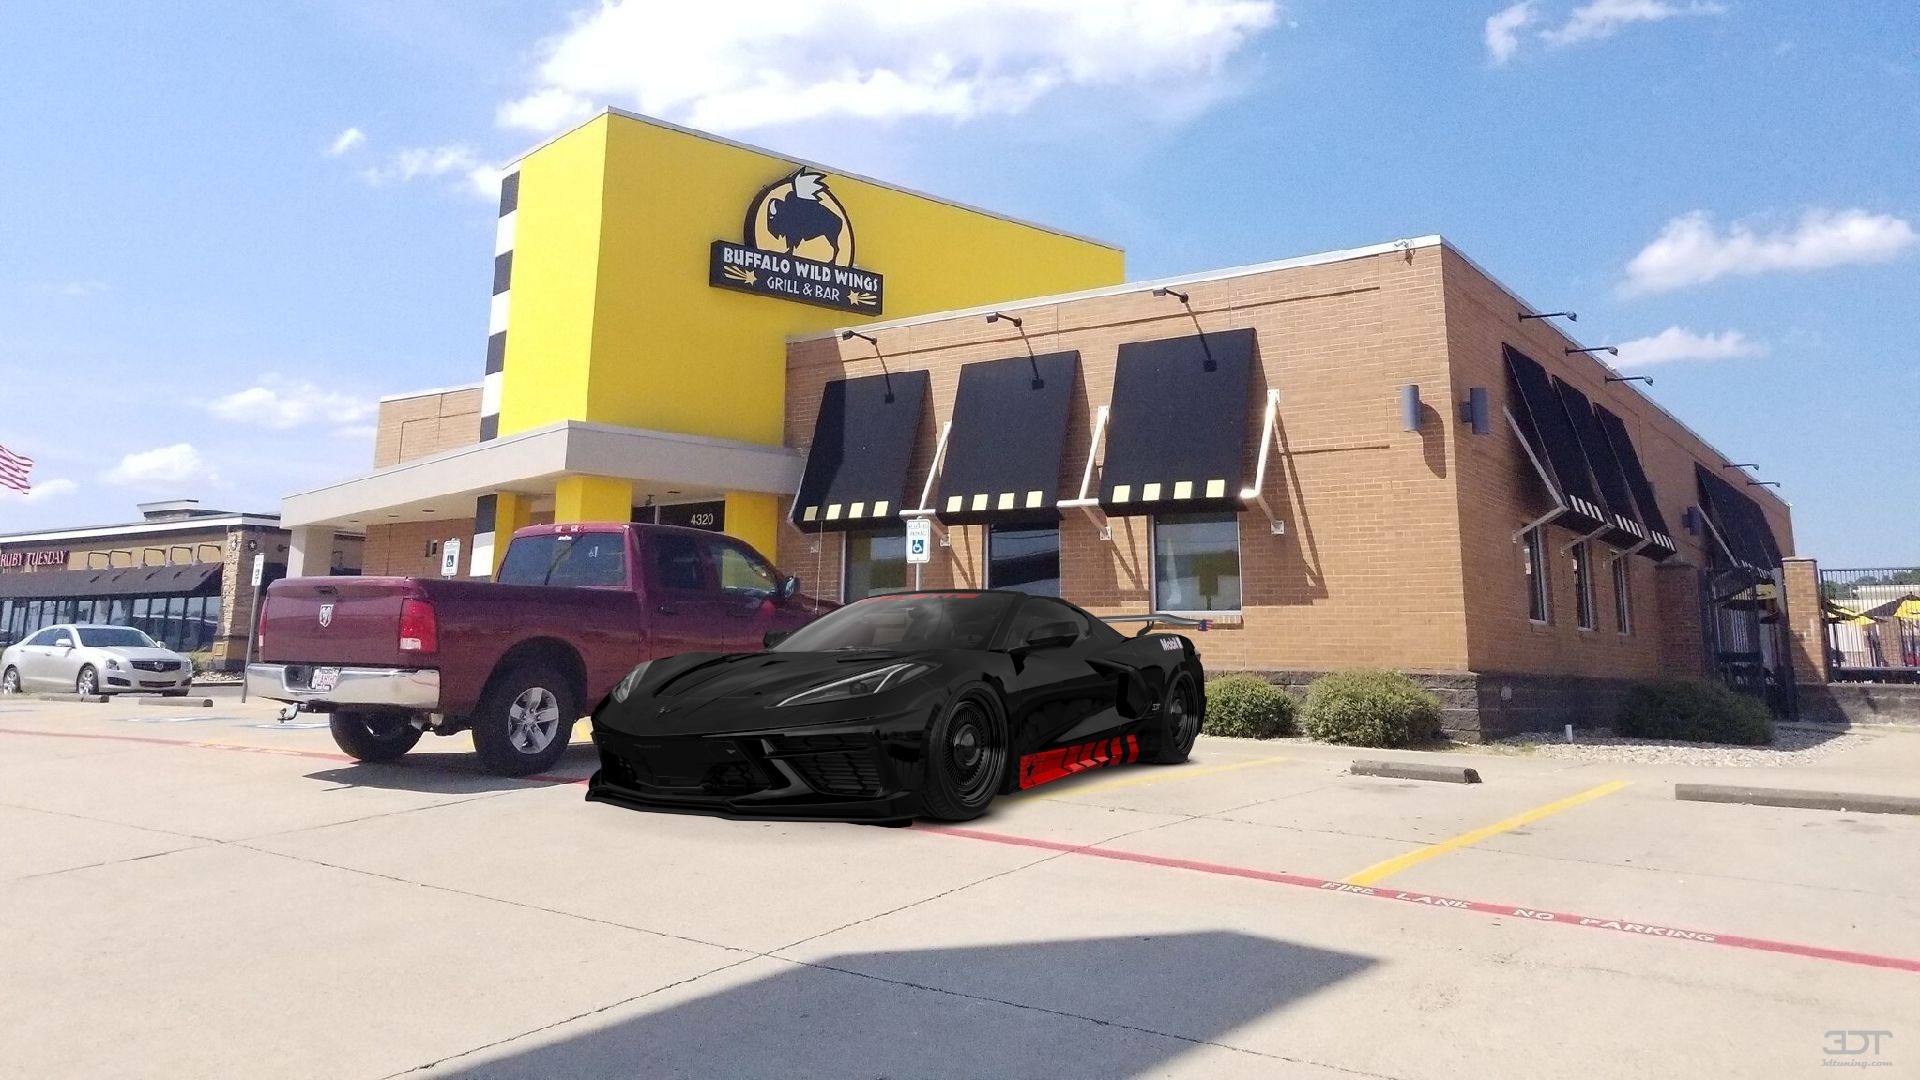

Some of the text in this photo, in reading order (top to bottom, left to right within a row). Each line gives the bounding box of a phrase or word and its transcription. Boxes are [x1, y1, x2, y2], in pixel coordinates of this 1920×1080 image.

[723, 247, 878, 292] BUFFALO WILD WINGS
[766, 276, 840, 302] GRILL & BAR
[691, 513, 714, 525] 4320
[0, 550, 65, 567] RUBY TUESDAY
[1395, 892, 1472, 909] LANE
[1512, 908, 1555, 920] NO
[1579, 917, 1715, 942] PARKING
